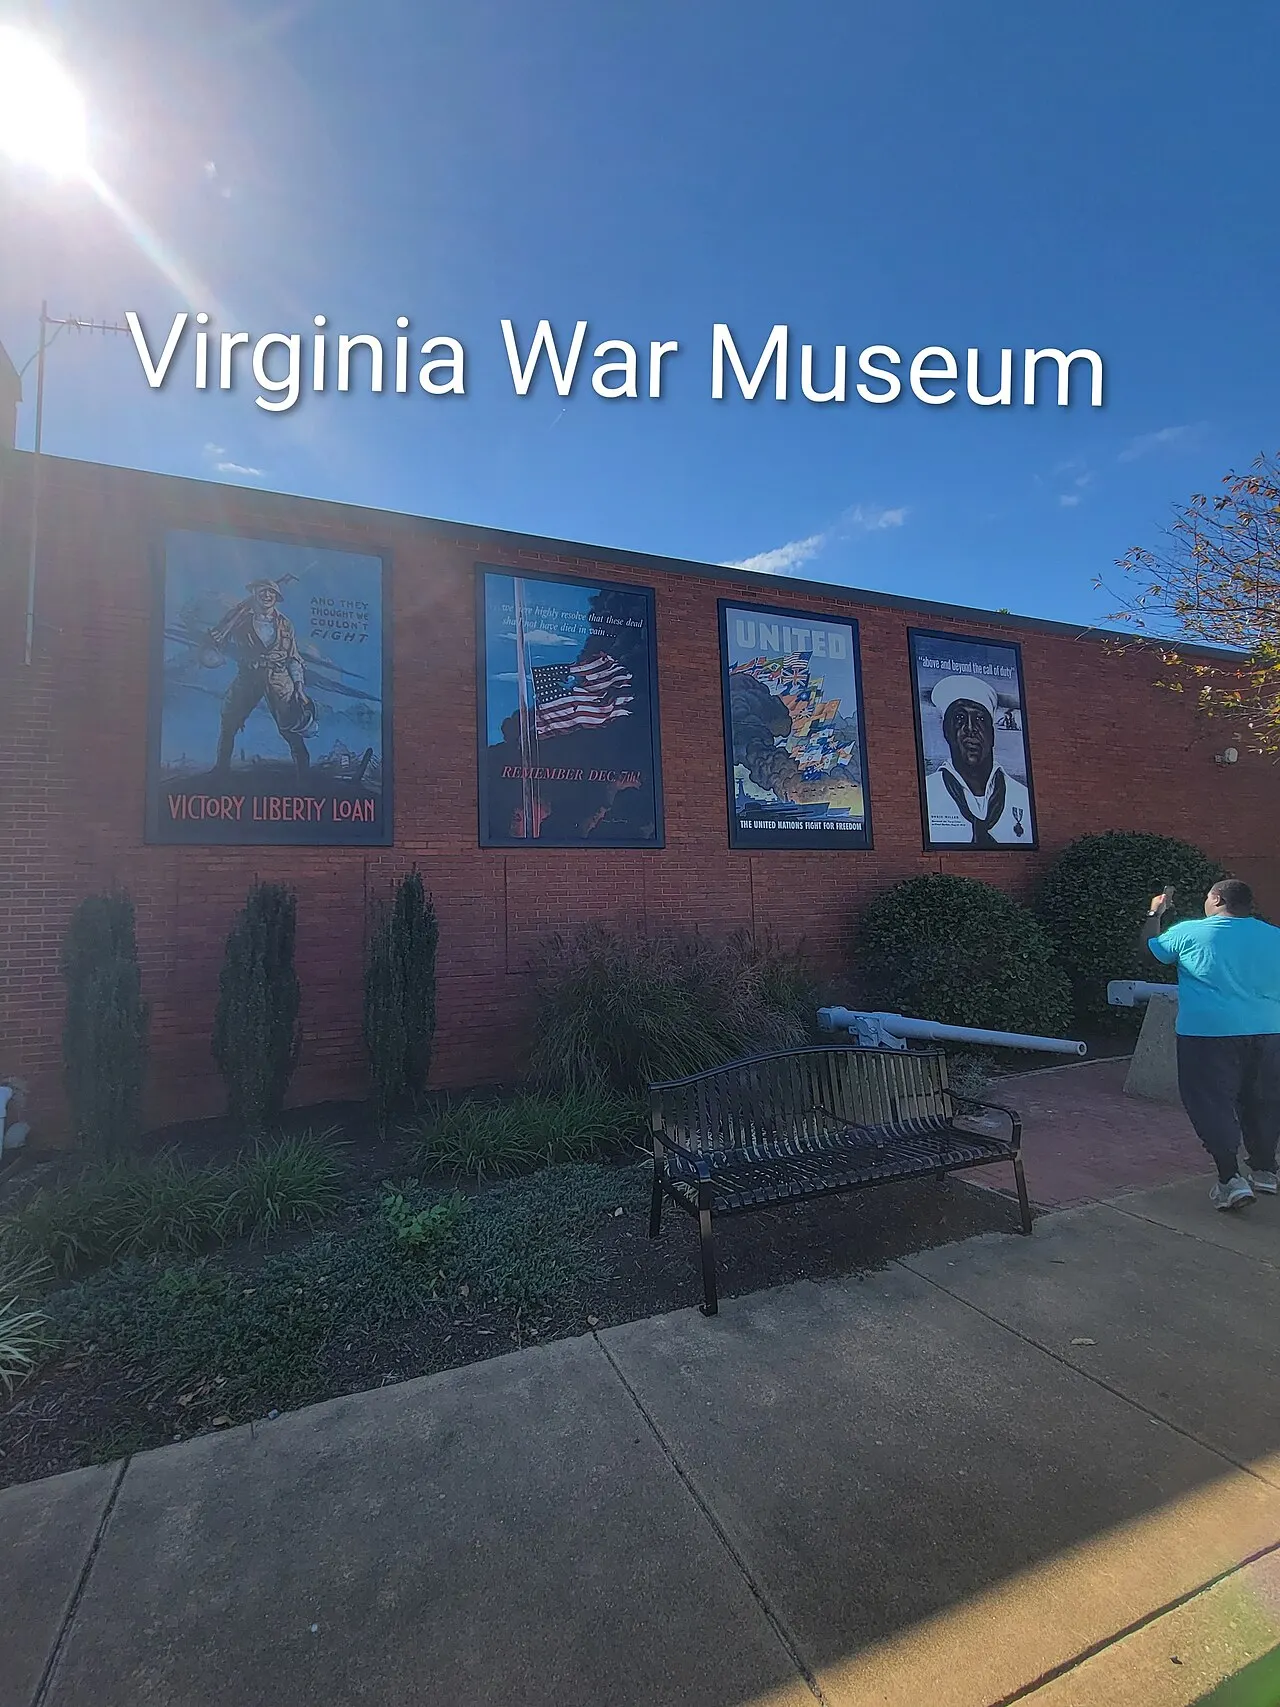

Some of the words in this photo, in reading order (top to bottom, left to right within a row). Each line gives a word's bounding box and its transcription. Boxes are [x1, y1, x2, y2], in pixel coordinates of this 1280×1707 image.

[310, 596, 335, 607] AND
[340, 600, 369, 610] THEY
[310, 607, 354, 618] THOUGHT
[356, 612, 369, 621] WE
[534, 605, 559, 620] highly
[561, 610, 587, 622] resolve
[588, 612, 604, 623] that
[606, 614, 624, 626] these
[625, 617, 644, 629] dead
[310, 618, 369, 630] COULDN'T
[502, 616, 523, 627] shal
[539, 619, 559, 631] have
[561, 623, 576, 634] died
[578, 625, 587, 634] in
[310, 629, 369, 643] FIGHT
[736, 620, 846, 659] UNITED
[940, 660, 951, 670] and
[952, 660, 972, 673] beyond
[972, 662, 982, 675] the
[983, 663, 993, 675] call
[993, 665, 1000, 676] of
[501, 767, 584, 780] REMEMBER
[588, 769, 617, 783] DEC.
[620, 770, 641, 784] 7th!
[168, 794, 246, 821] VICTORY
[252, 796, 327, 822] LIBERTY
[332, 798, 376, 823] LOAN
[740, 820, 752, 828] THE
[753, 820, 776, 829] UNITED
[778, 821, 803, 829] NATIONS
[805, 821, 821, 830] FIGHT
[823, 822, 834, 830] FOR
[836, 822, 862, 830] FREEDOM
